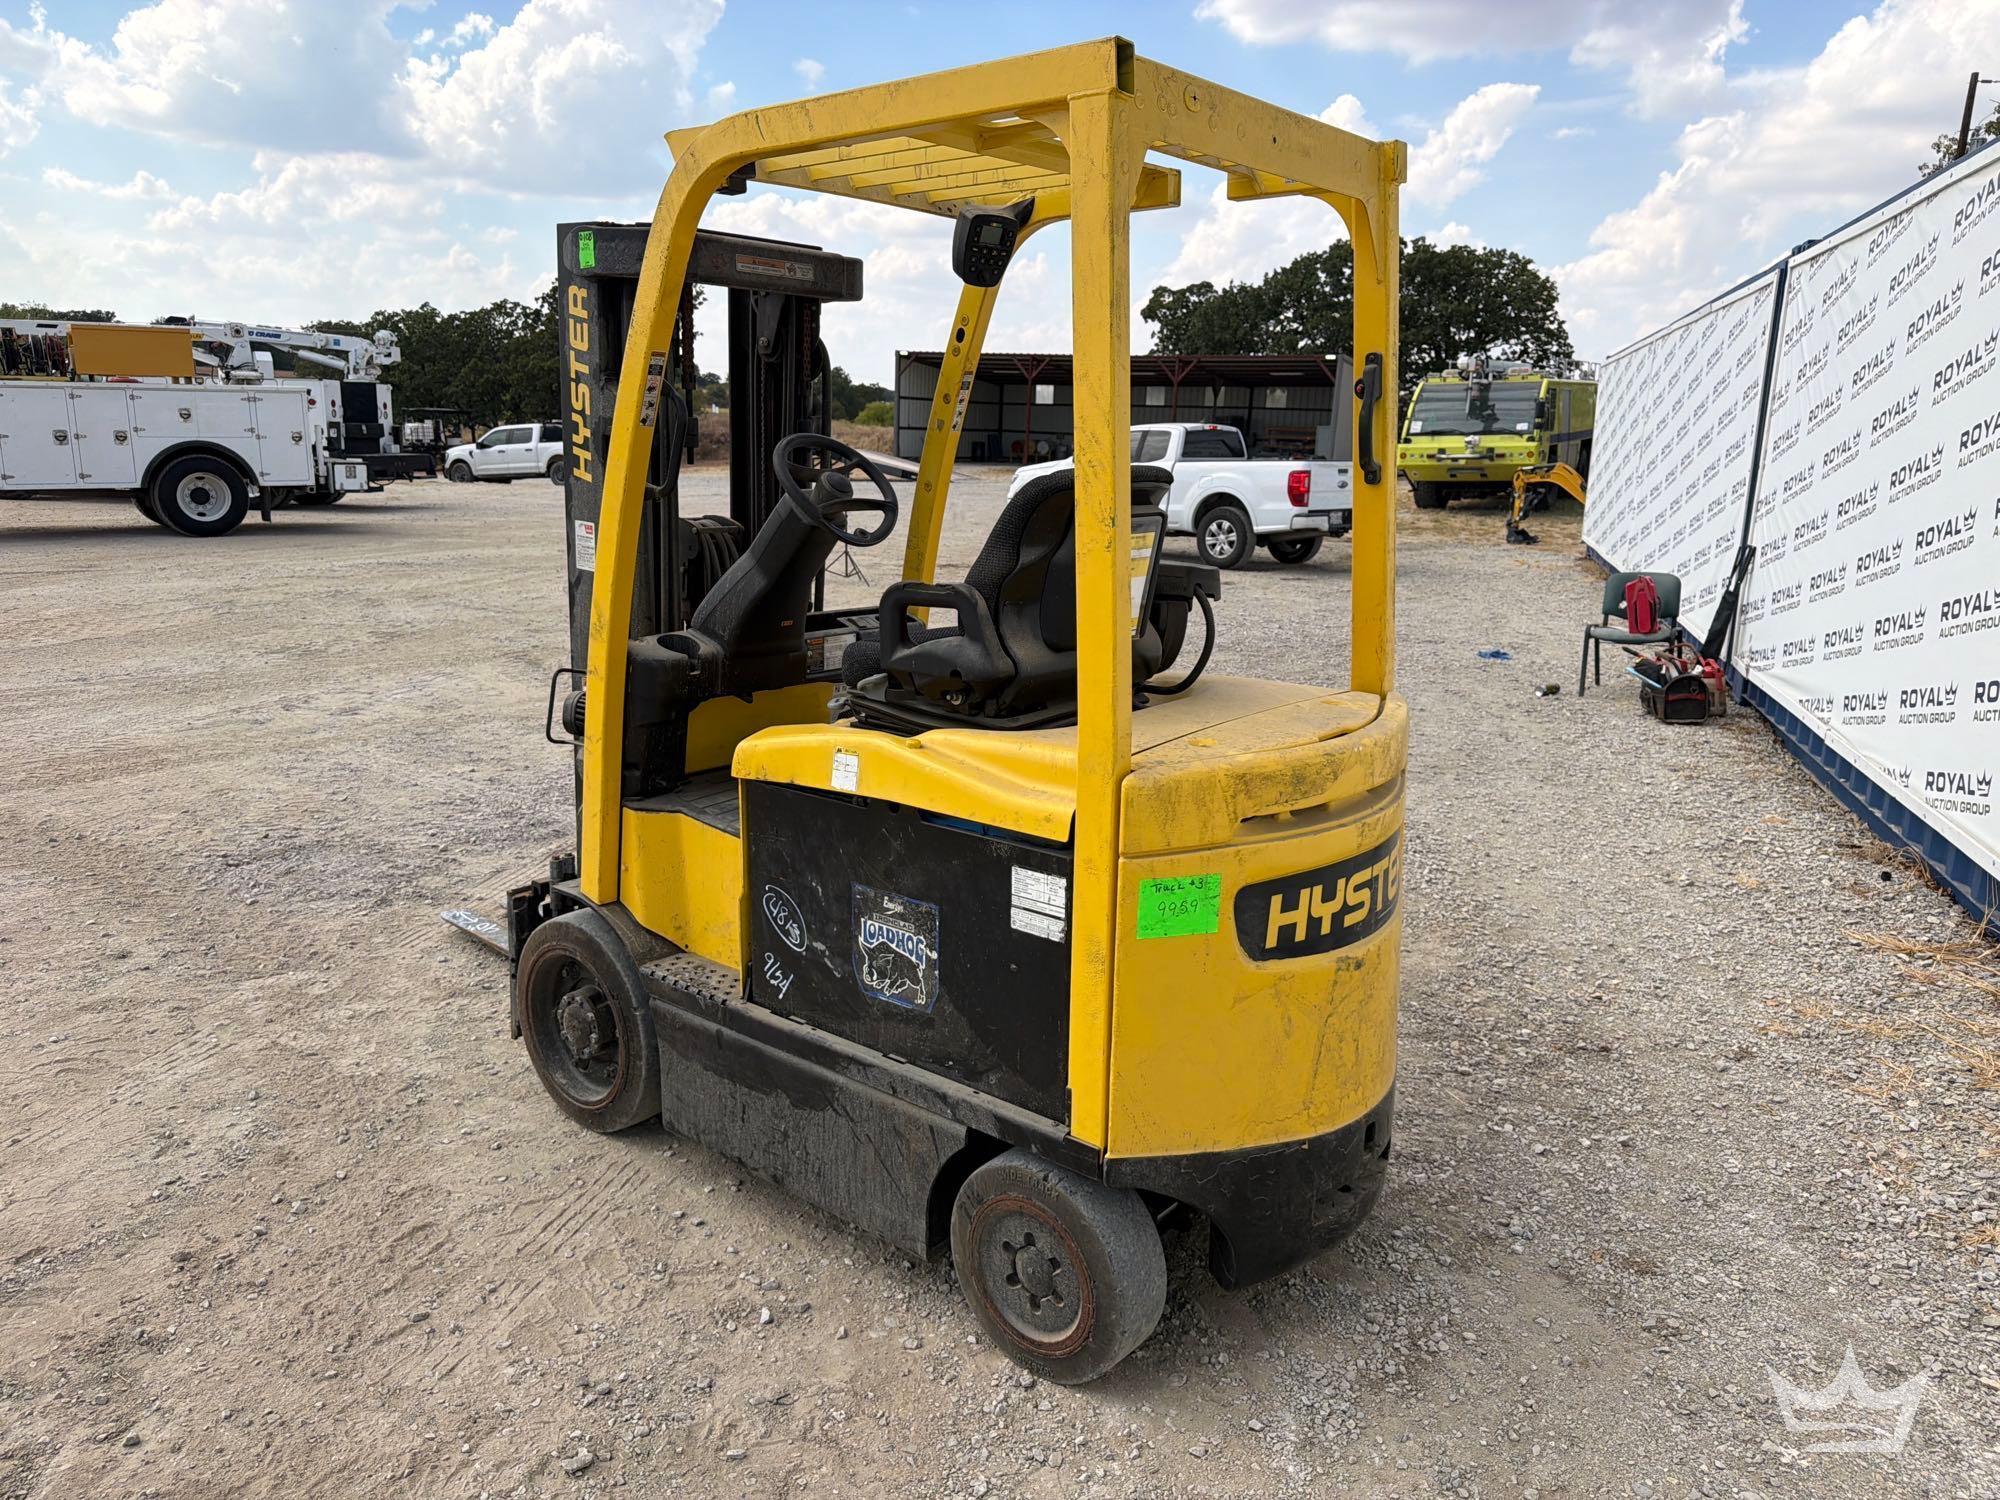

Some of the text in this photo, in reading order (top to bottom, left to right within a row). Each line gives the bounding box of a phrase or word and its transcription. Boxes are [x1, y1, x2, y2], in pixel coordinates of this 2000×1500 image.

[1952, 207, 1987, 248] AUCTION
[1887, 255, 1936, 310] AUCTION GROUP
[1888, 246, 1927, 295] ROYAL
[1821, 276, 1856, 318] AUCTION GROUP
[1822, 268, 1848, 307] ROYAL
[1838, 304, 1867, 344] ROYAL
[1905, 304, 1961, 357] AUCTION GROUP
[1907, 294, 1949, 342] ROYAL
[1836, 314, 1876, 356] AUCTION GROUP
[1796, 360, 1828, 393] AUCTION GROUP
[1797, 350, 1822, 382] ROYAL
[1850, 360, 1893, 401] AUCTION GROUP
[1852, 349, 1884, 389] ROYAL
[1933, 344, 1982, 392] ROYAL
[568, 284, 593, 483] HYSTER
[1931, 357, 1996, 408] AUCTION GROUP
[1806, 403, 1841, 436] AUCTION GROUP
[1808, 392, 1834, 424] ROYAL
[1871, 396, 1907, 435] ROYAL
[1773, 426, 1793, 453] ROYAL
[1869, 410, 1917, 449] AUCTION GROUP
[1821, 449, 1859, 480] AUCTION GROUP
[1823, 437, 1852, 468] ROYAL
[1957, 440, 1995, 469] AUCTION
[1783, 468, 1807, 494] ROYAL
[1888, 469, 1941, 504] AUCTION GROUP
[1890, 453, 1930, 490] ROYAL
[1782, 480, 1813, 504] AUCTION GROUP
[1837, 488, 1869, 519] ROYAL
[1794, 516, 1820, 541] ROYAL
[1836, 504, 1877, 531] AUCTION GROUP
[1915, 515, 1961, 551] ROYAL
[1760, 537, 1780, 558] ROYAL
[1793, 530, 1827, 552] AUCTION GROUP
[1914, 535, 1974, 566] AUCTION GROUP
[1856, 544, 1891, 574] ROYAL
[1809, 568, 1838, 591] ROYAL
[1855, 563, 1900, 587] AUCTION GROUP
[1772, 585, 1794, 605] ROYAL
[1809, 584, 1845, 602] AUCTION GROUP
[1940, 590, 1992, 622] ROYAL
[1824, 626, 1854, 648] ROYAL
[1874, 611, 1913, 637] ROYAL
[1939, 622, 1974, 639] AUCTION
[1783, 638, 1807, 657] ROYAL
[1823, 646, 1862, 661] AUCTION GROUP
[1873, 633, 1924, 651] AUCTION GROUP
[1843, 693, 1876, 712] ROYAL
[1900, 687, 1943, 708] ROYAL
[1842, 716, 1865, 725] AUCTION
[1866, 715, 1886, 725] GROUP
[1899, 711, 1955, 724] AUCTION GROUP
[1973, 709, 2000, 721] AUCT
[1925, 771, 1975, 796] ROYAL
[1960, 800, 1990, 816] GROUP
[1158, 899, 1198, 917] 9959
[1265, 843, 1399, 949] HYSTE
[875, 914, 913, 931] IRONCLAD
[861, 918, 926, 968] LOADHOG
